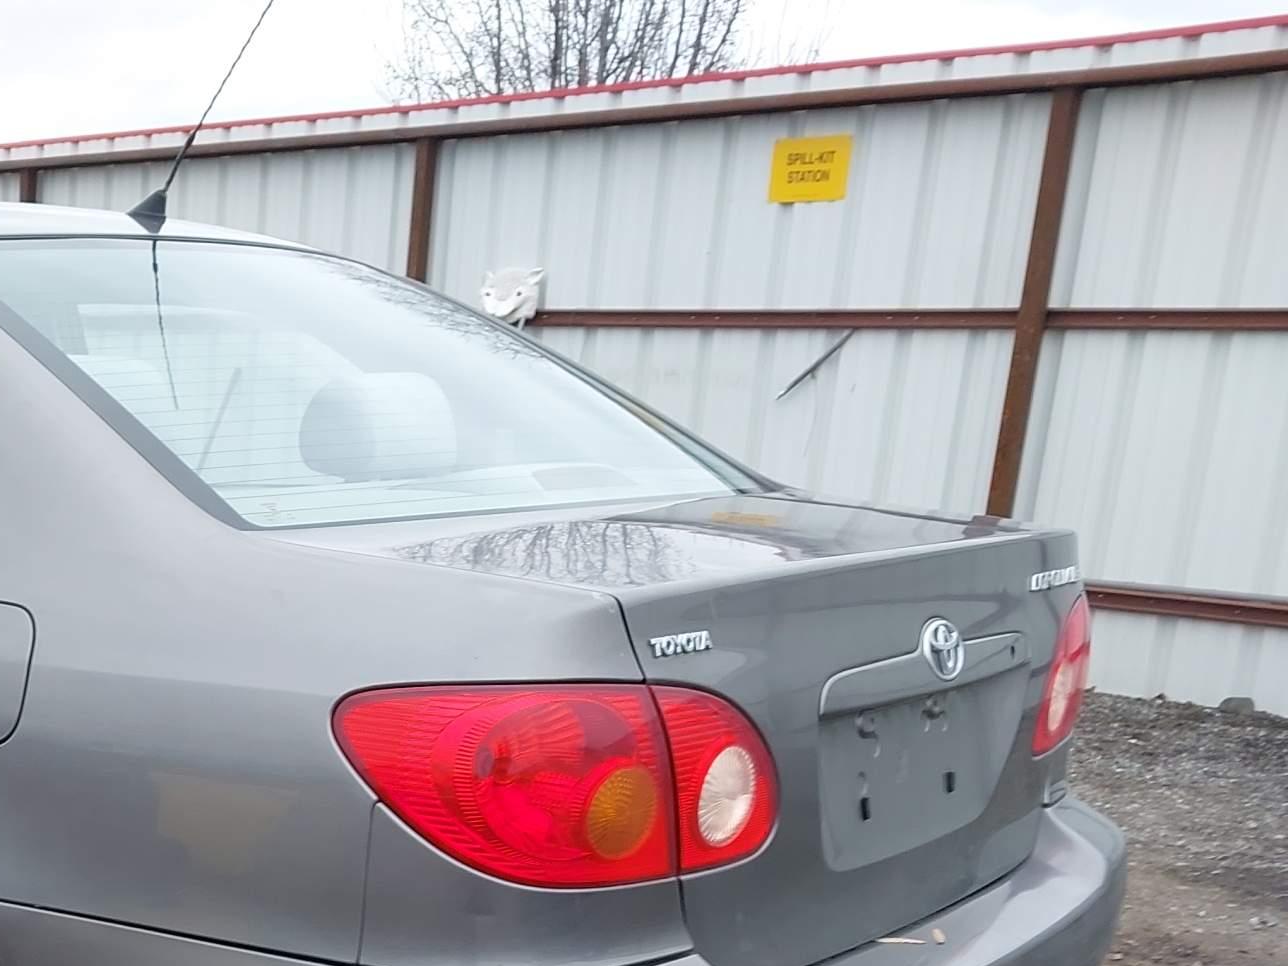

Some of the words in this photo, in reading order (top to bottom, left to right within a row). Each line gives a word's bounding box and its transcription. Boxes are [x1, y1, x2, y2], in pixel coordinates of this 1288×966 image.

[786, 150, 836, 166] SPILL-KIT
[787, 169, 830, 184] STATION
[649, 630, 712, 657] TOYOTA
